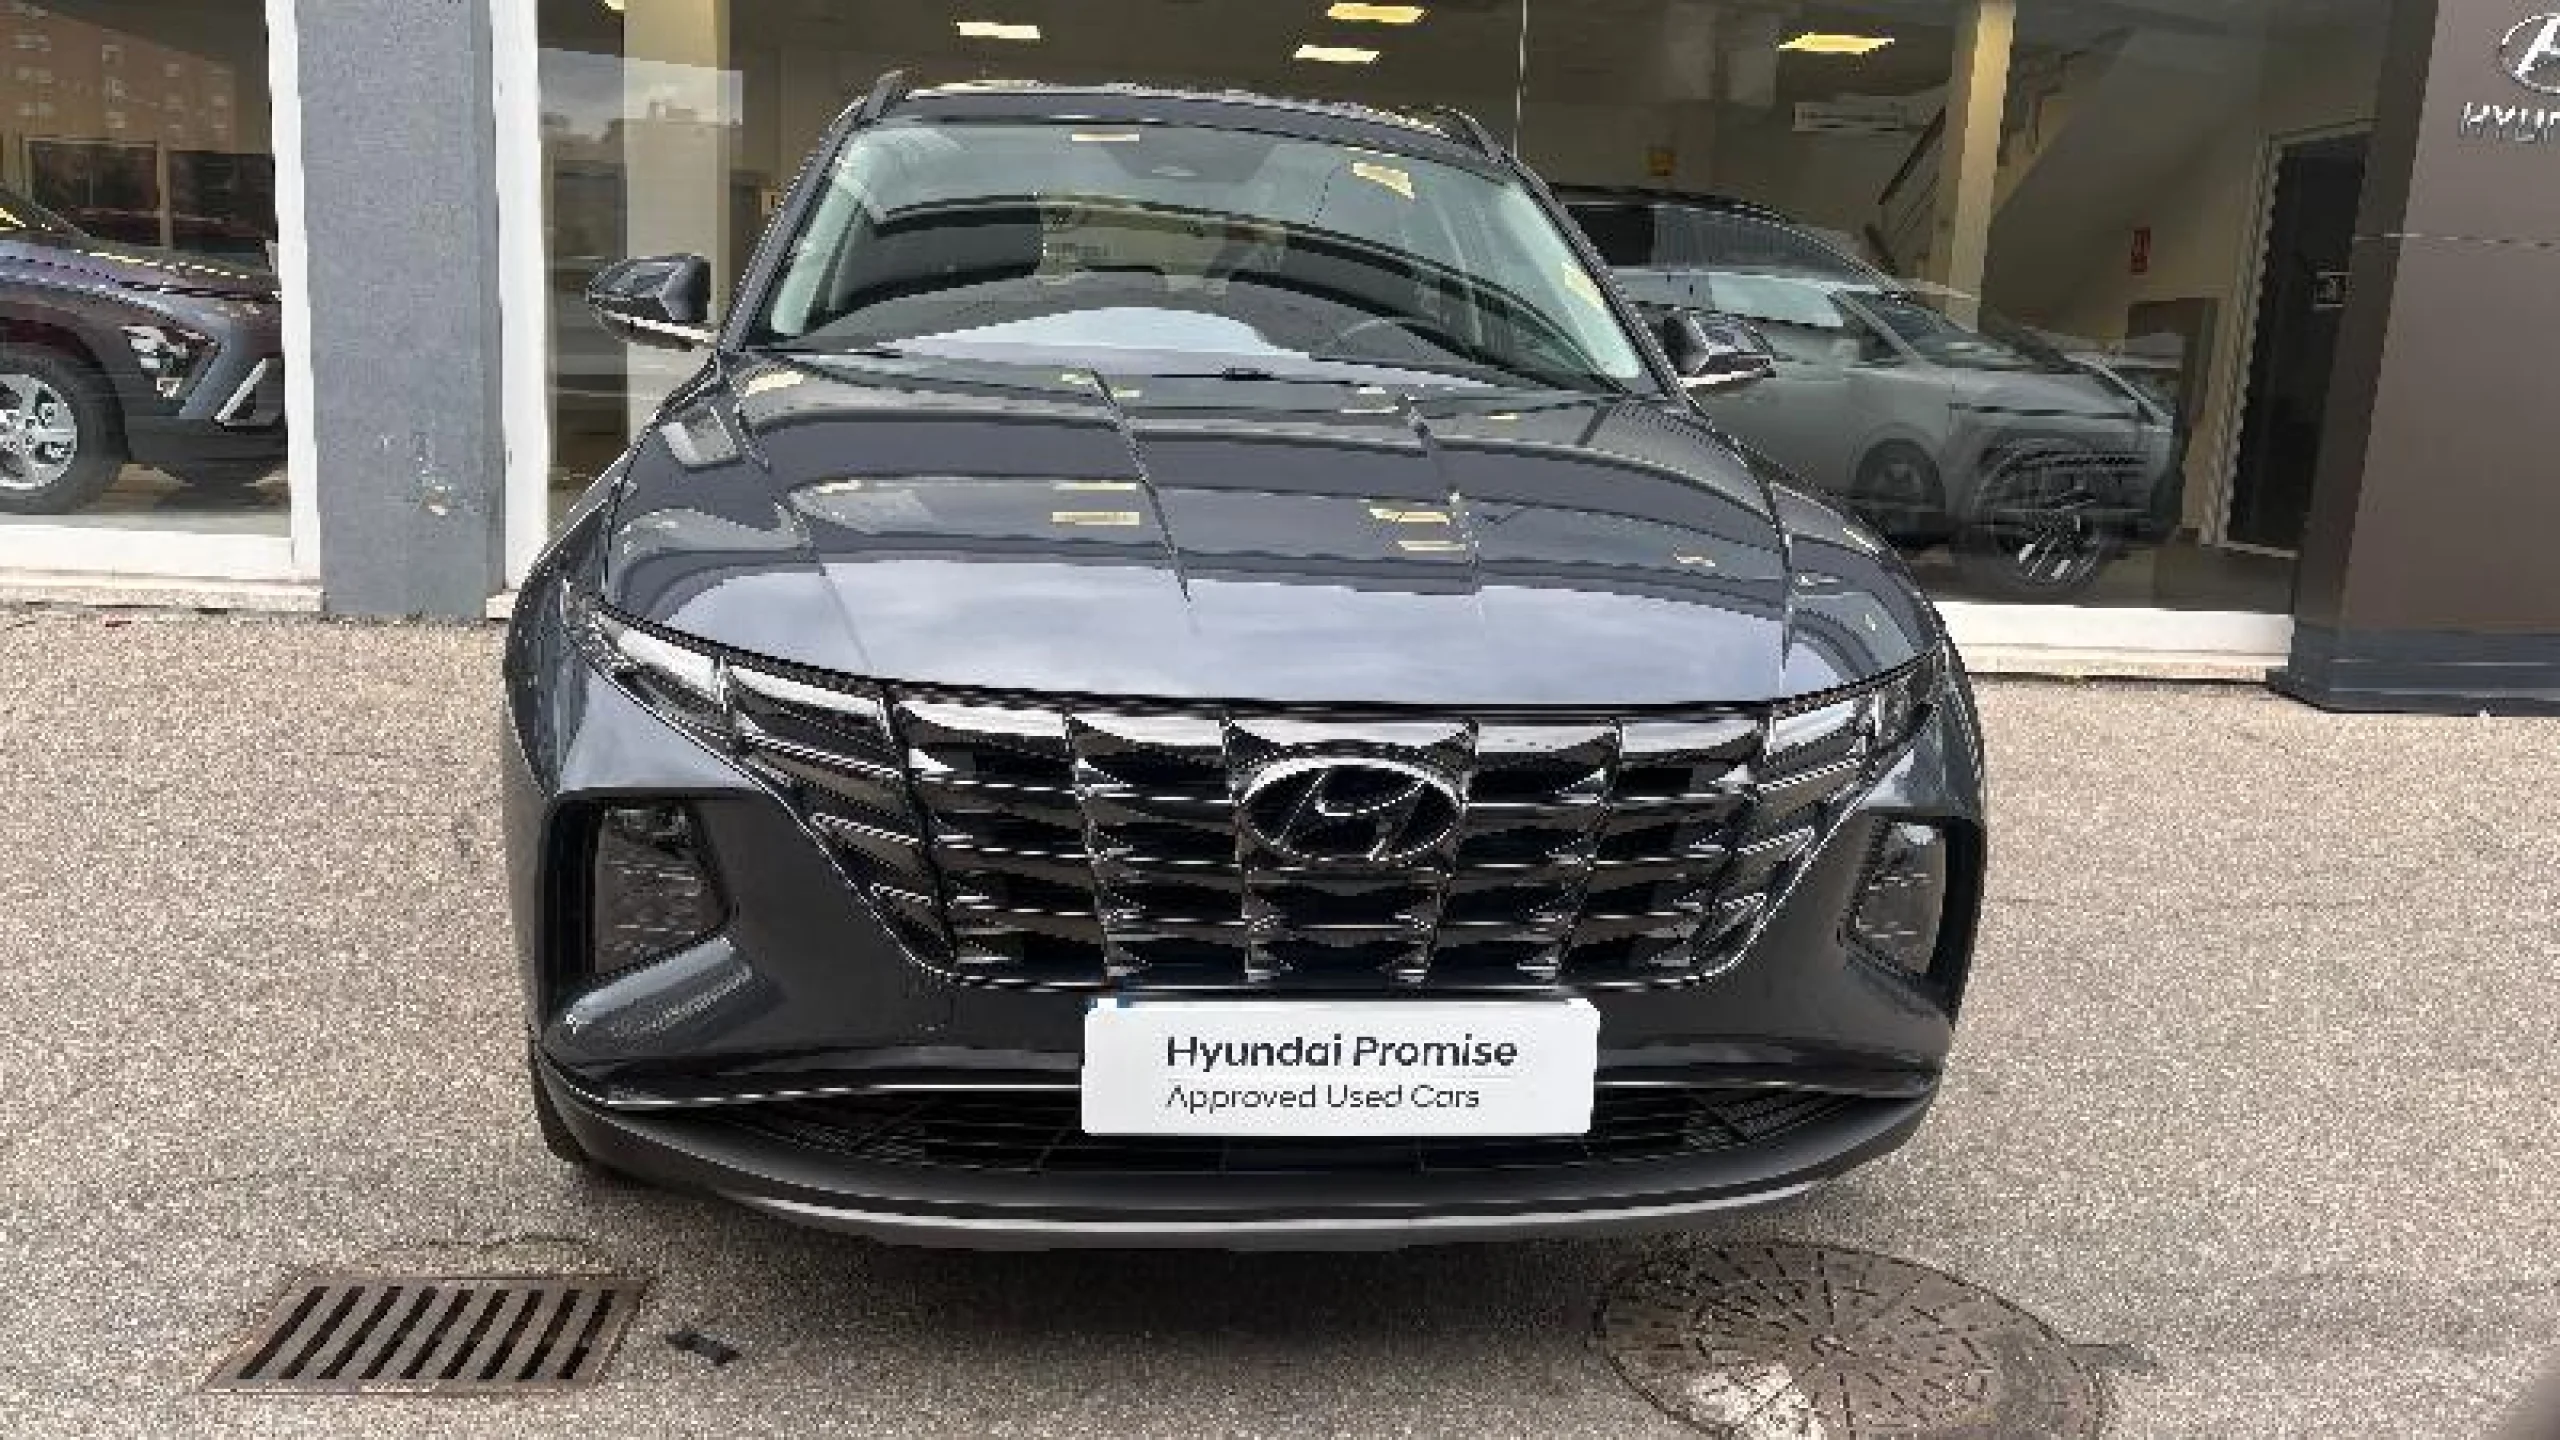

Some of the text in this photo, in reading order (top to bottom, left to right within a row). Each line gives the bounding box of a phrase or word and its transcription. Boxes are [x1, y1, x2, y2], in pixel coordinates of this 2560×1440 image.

[1168, 1033, 1518, 1072] Hyundai Promise
[1165, 1084, 1479, 1114] Approved Used Cars
